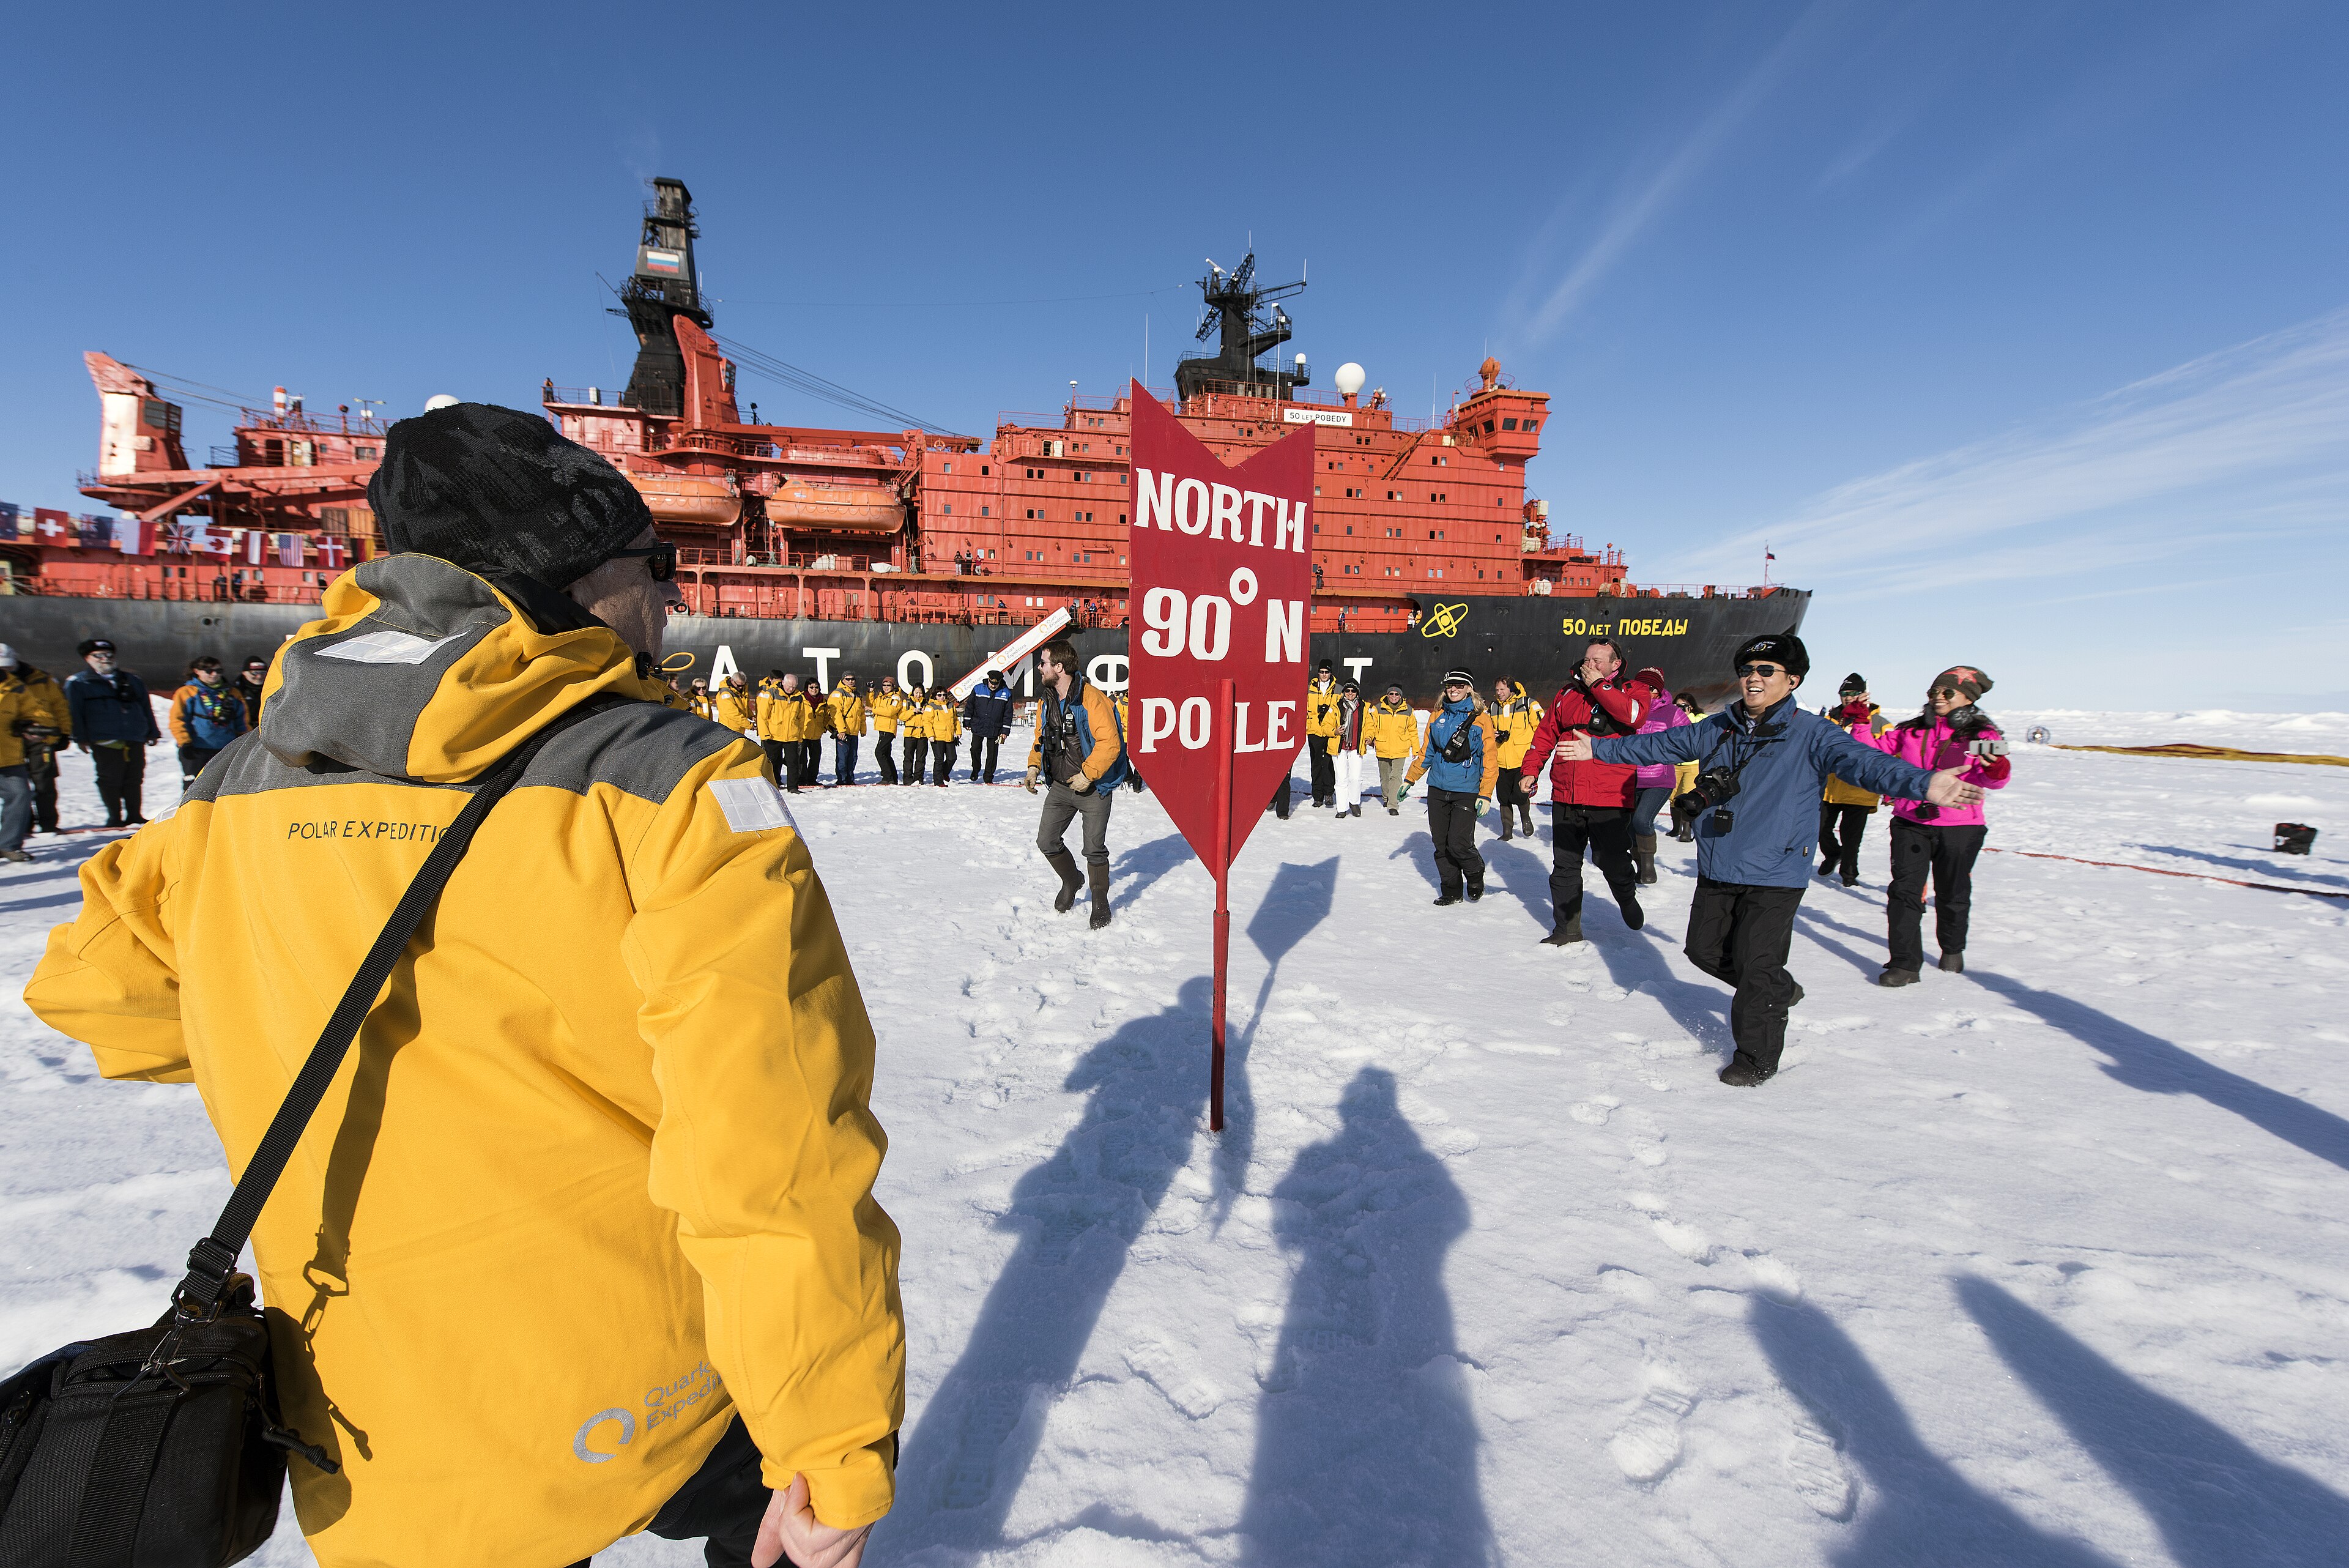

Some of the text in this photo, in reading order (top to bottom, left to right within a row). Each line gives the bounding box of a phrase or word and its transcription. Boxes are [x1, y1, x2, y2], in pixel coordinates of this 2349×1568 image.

[1315, 414, 1346, 423] POBEDY
[1134, 467, 1308, 554] NORTH
[1264, 598, 1304, 663] N
[1562, 619, 1586, 636] 50
[1618, 619, 1688, 636] ПОБЕДЫ
[288, 820, 337, 839] POLAR
[644, 1361, 711, 1407] Quark
